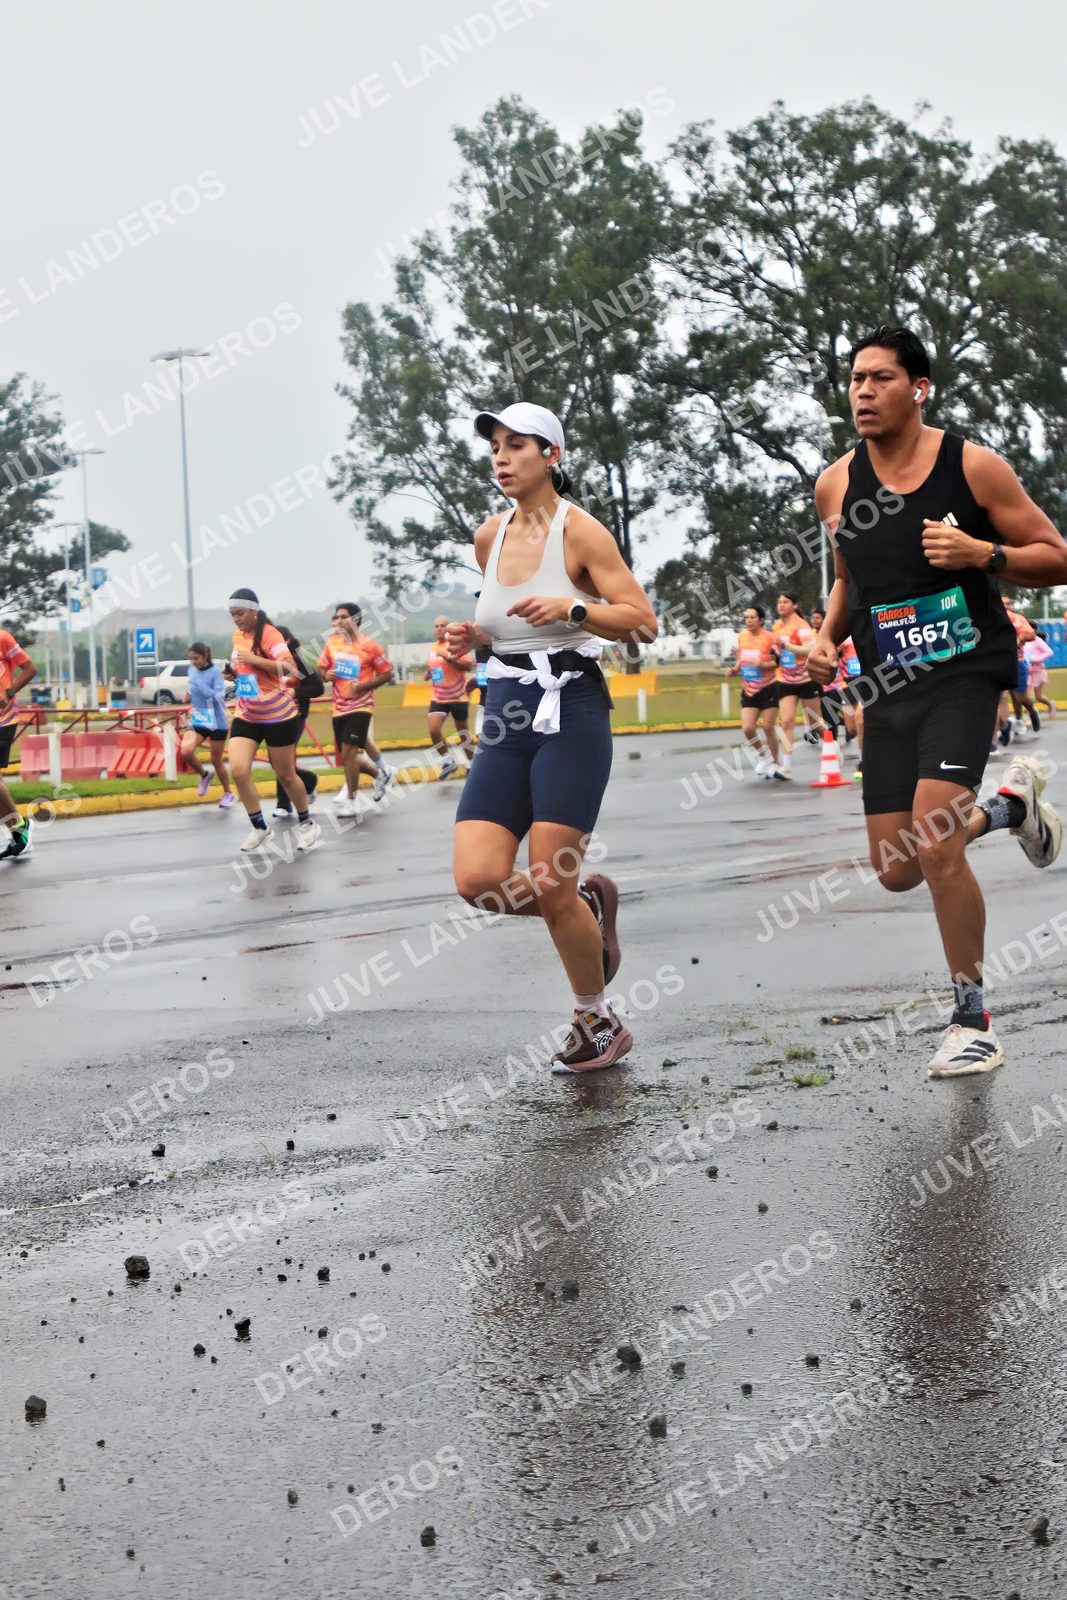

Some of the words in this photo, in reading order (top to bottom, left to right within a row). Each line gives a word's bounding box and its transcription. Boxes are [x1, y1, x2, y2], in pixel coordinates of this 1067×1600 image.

[940, 594, 958, 610] 10K
[877, 606, 916, 622] CARRERA
[879, 618, 908, 630] OMNILIFE
[894, 620, 948, 648] 1667
